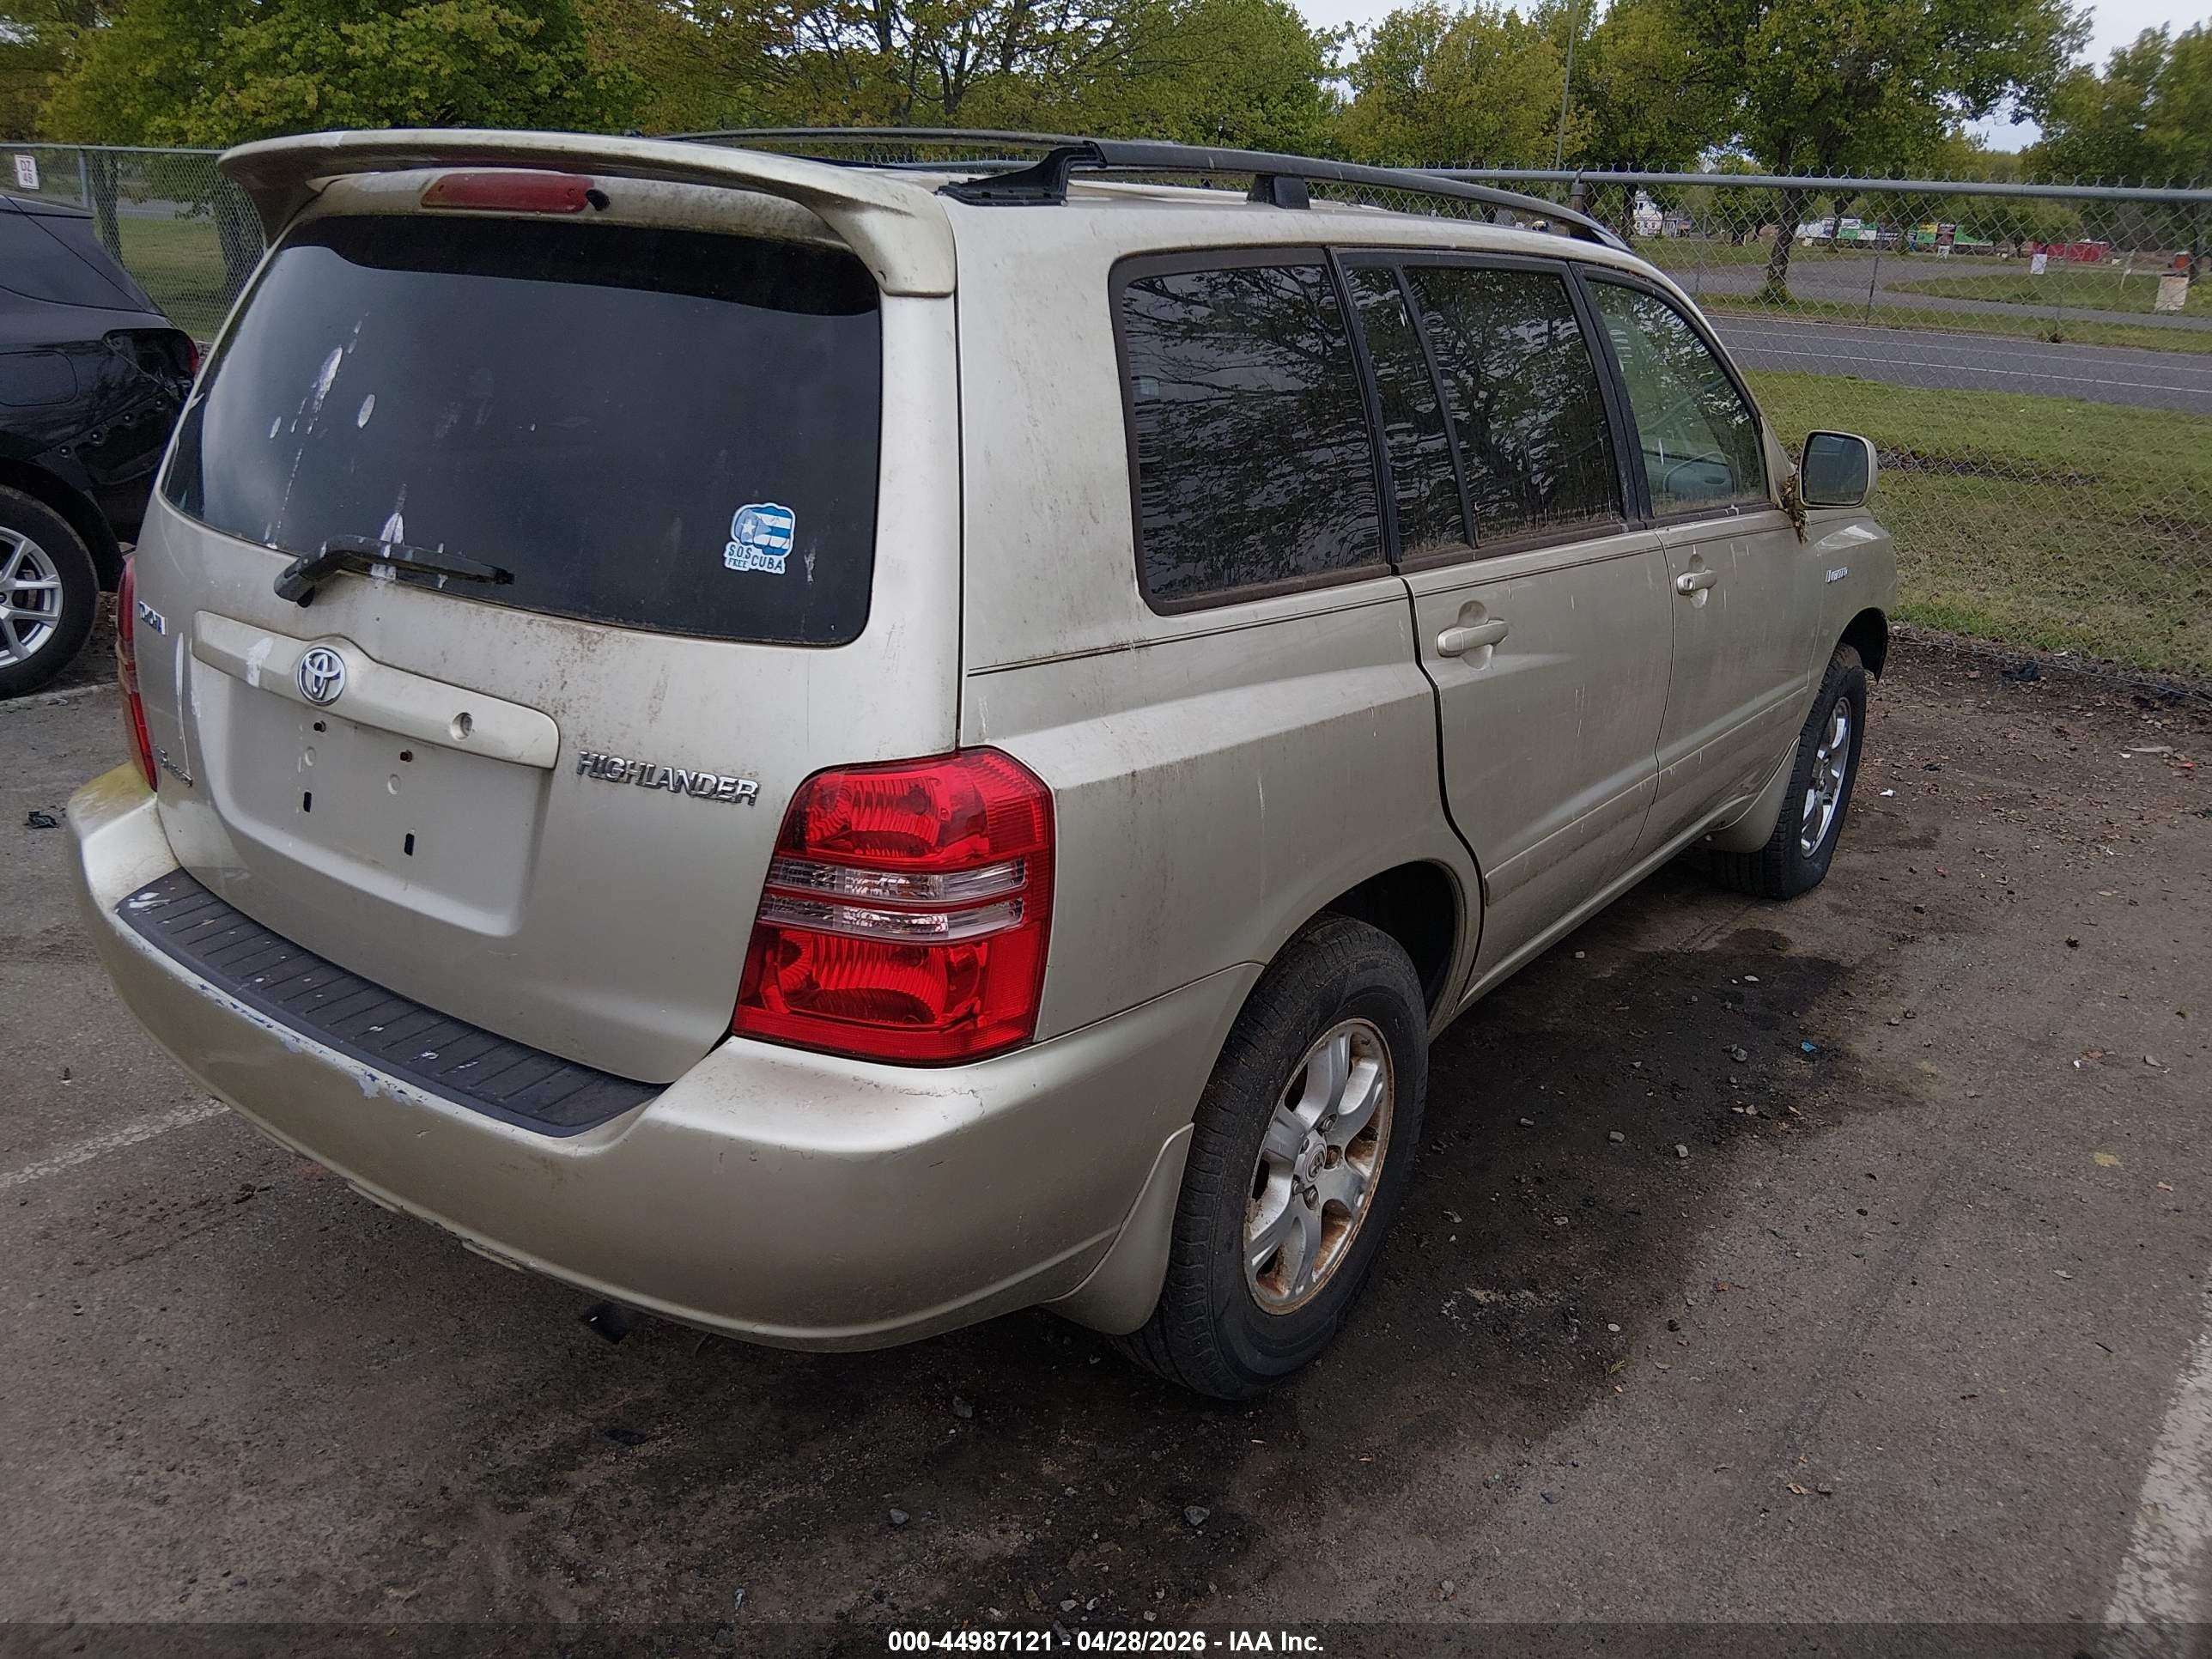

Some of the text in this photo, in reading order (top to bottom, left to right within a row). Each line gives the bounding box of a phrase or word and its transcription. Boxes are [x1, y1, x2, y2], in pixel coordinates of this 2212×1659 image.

[727, 557, 748, 568] FREE
[750, 555, 783, 572] CUBA
[576, 750, 759, 806] HIGHLANDER
